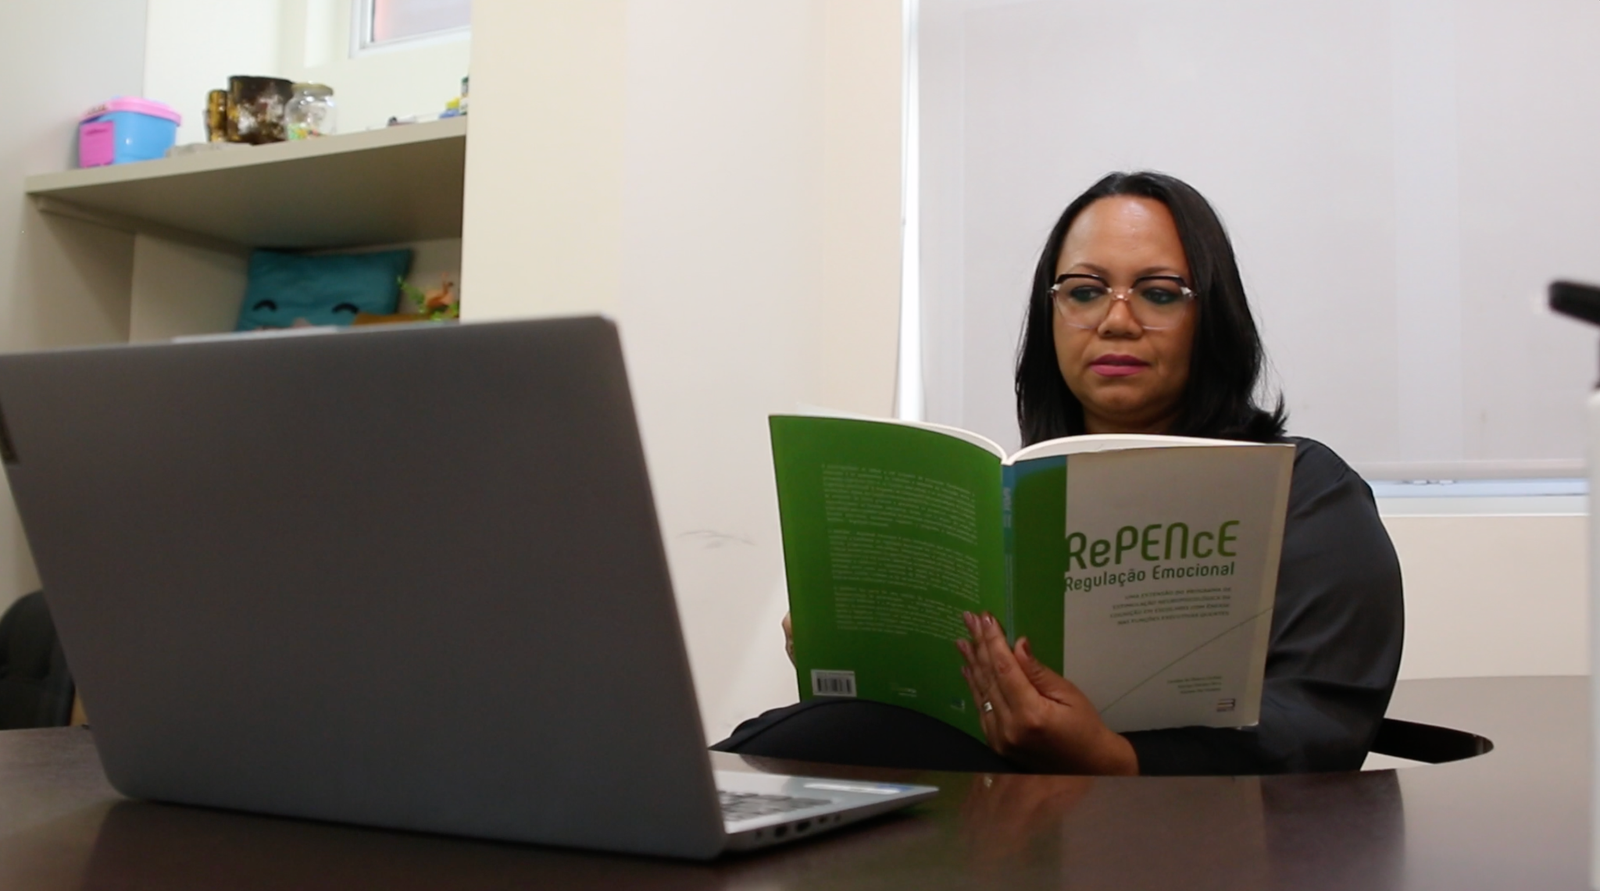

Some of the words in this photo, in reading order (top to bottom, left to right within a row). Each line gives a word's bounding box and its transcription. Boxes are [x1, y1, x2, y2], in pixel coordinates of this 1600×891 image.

[1064, 568, 1146, 592] Regulação
[1152, 561, 1235, 580] Emocional
[1141, 590, 1173, 598] EXTENSÃO
